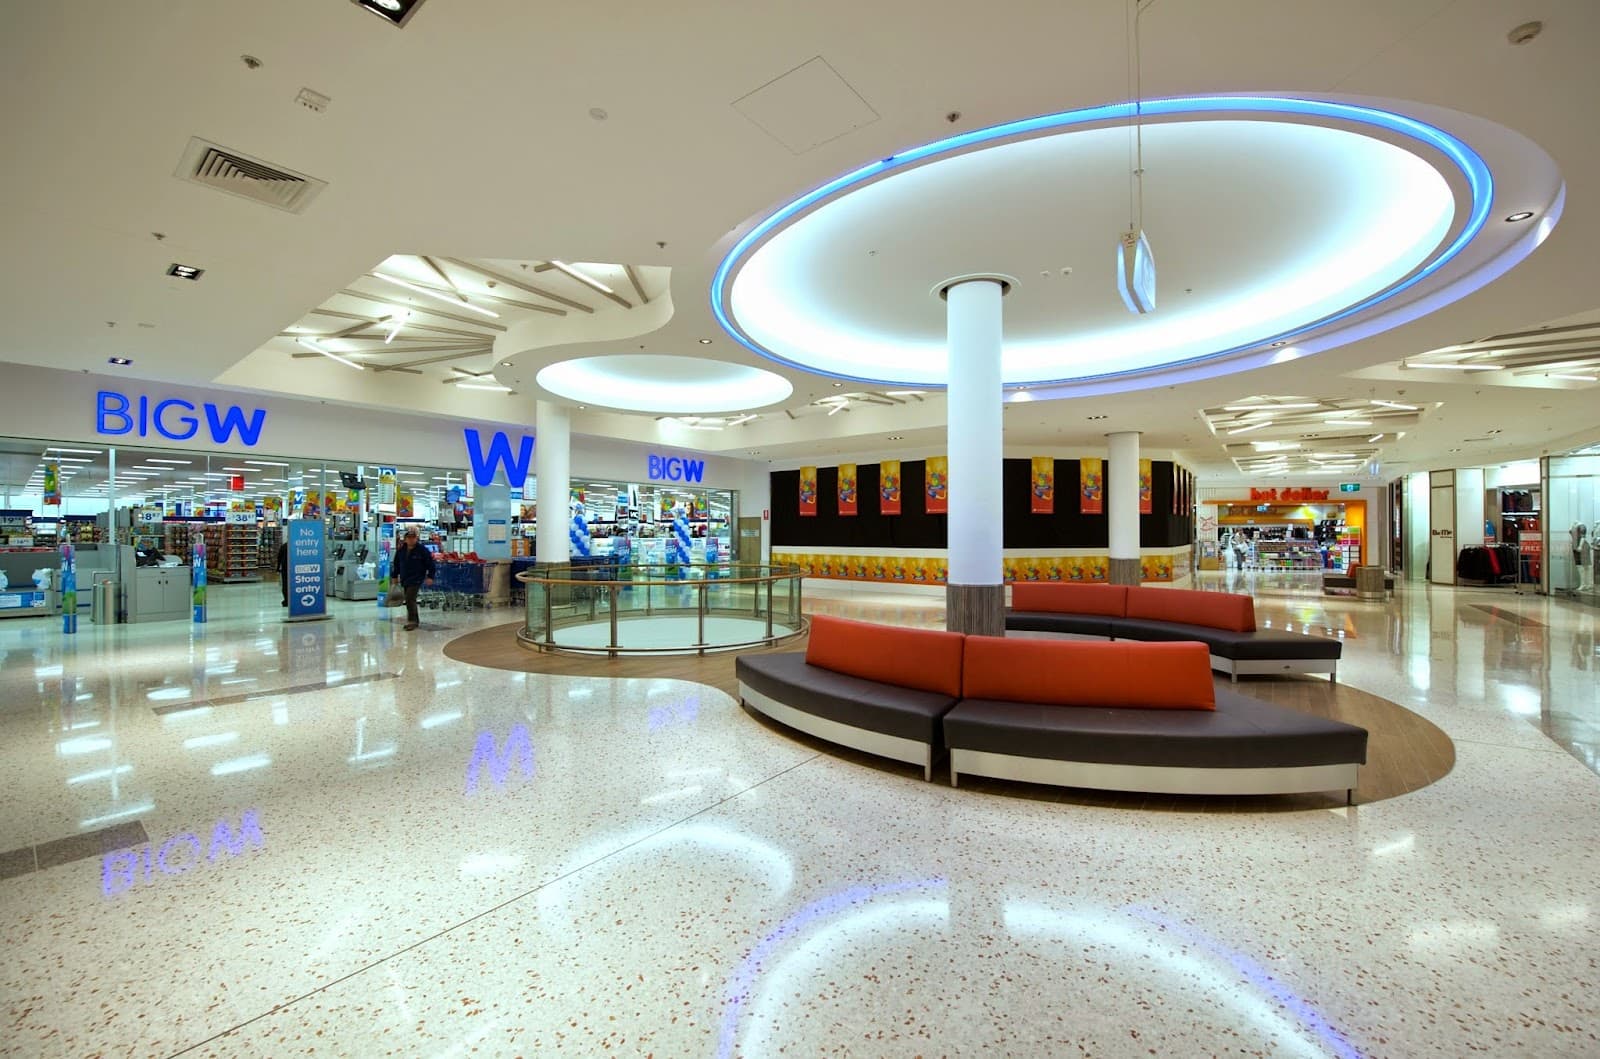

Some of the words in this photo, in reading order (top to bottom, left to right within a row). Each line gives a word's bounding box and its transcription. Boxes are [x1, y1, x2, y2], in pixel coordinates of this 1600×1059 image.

[464, 428, 535, 488] W
[1280, 487, 1329, 500] dollar
[300, 528, 314, 536] No
[295, 538, 320, 547] entry
[296, 547, 318, 556] here
[295, 575, 320, 583] Store
[295, 585, 320, 594] entry
